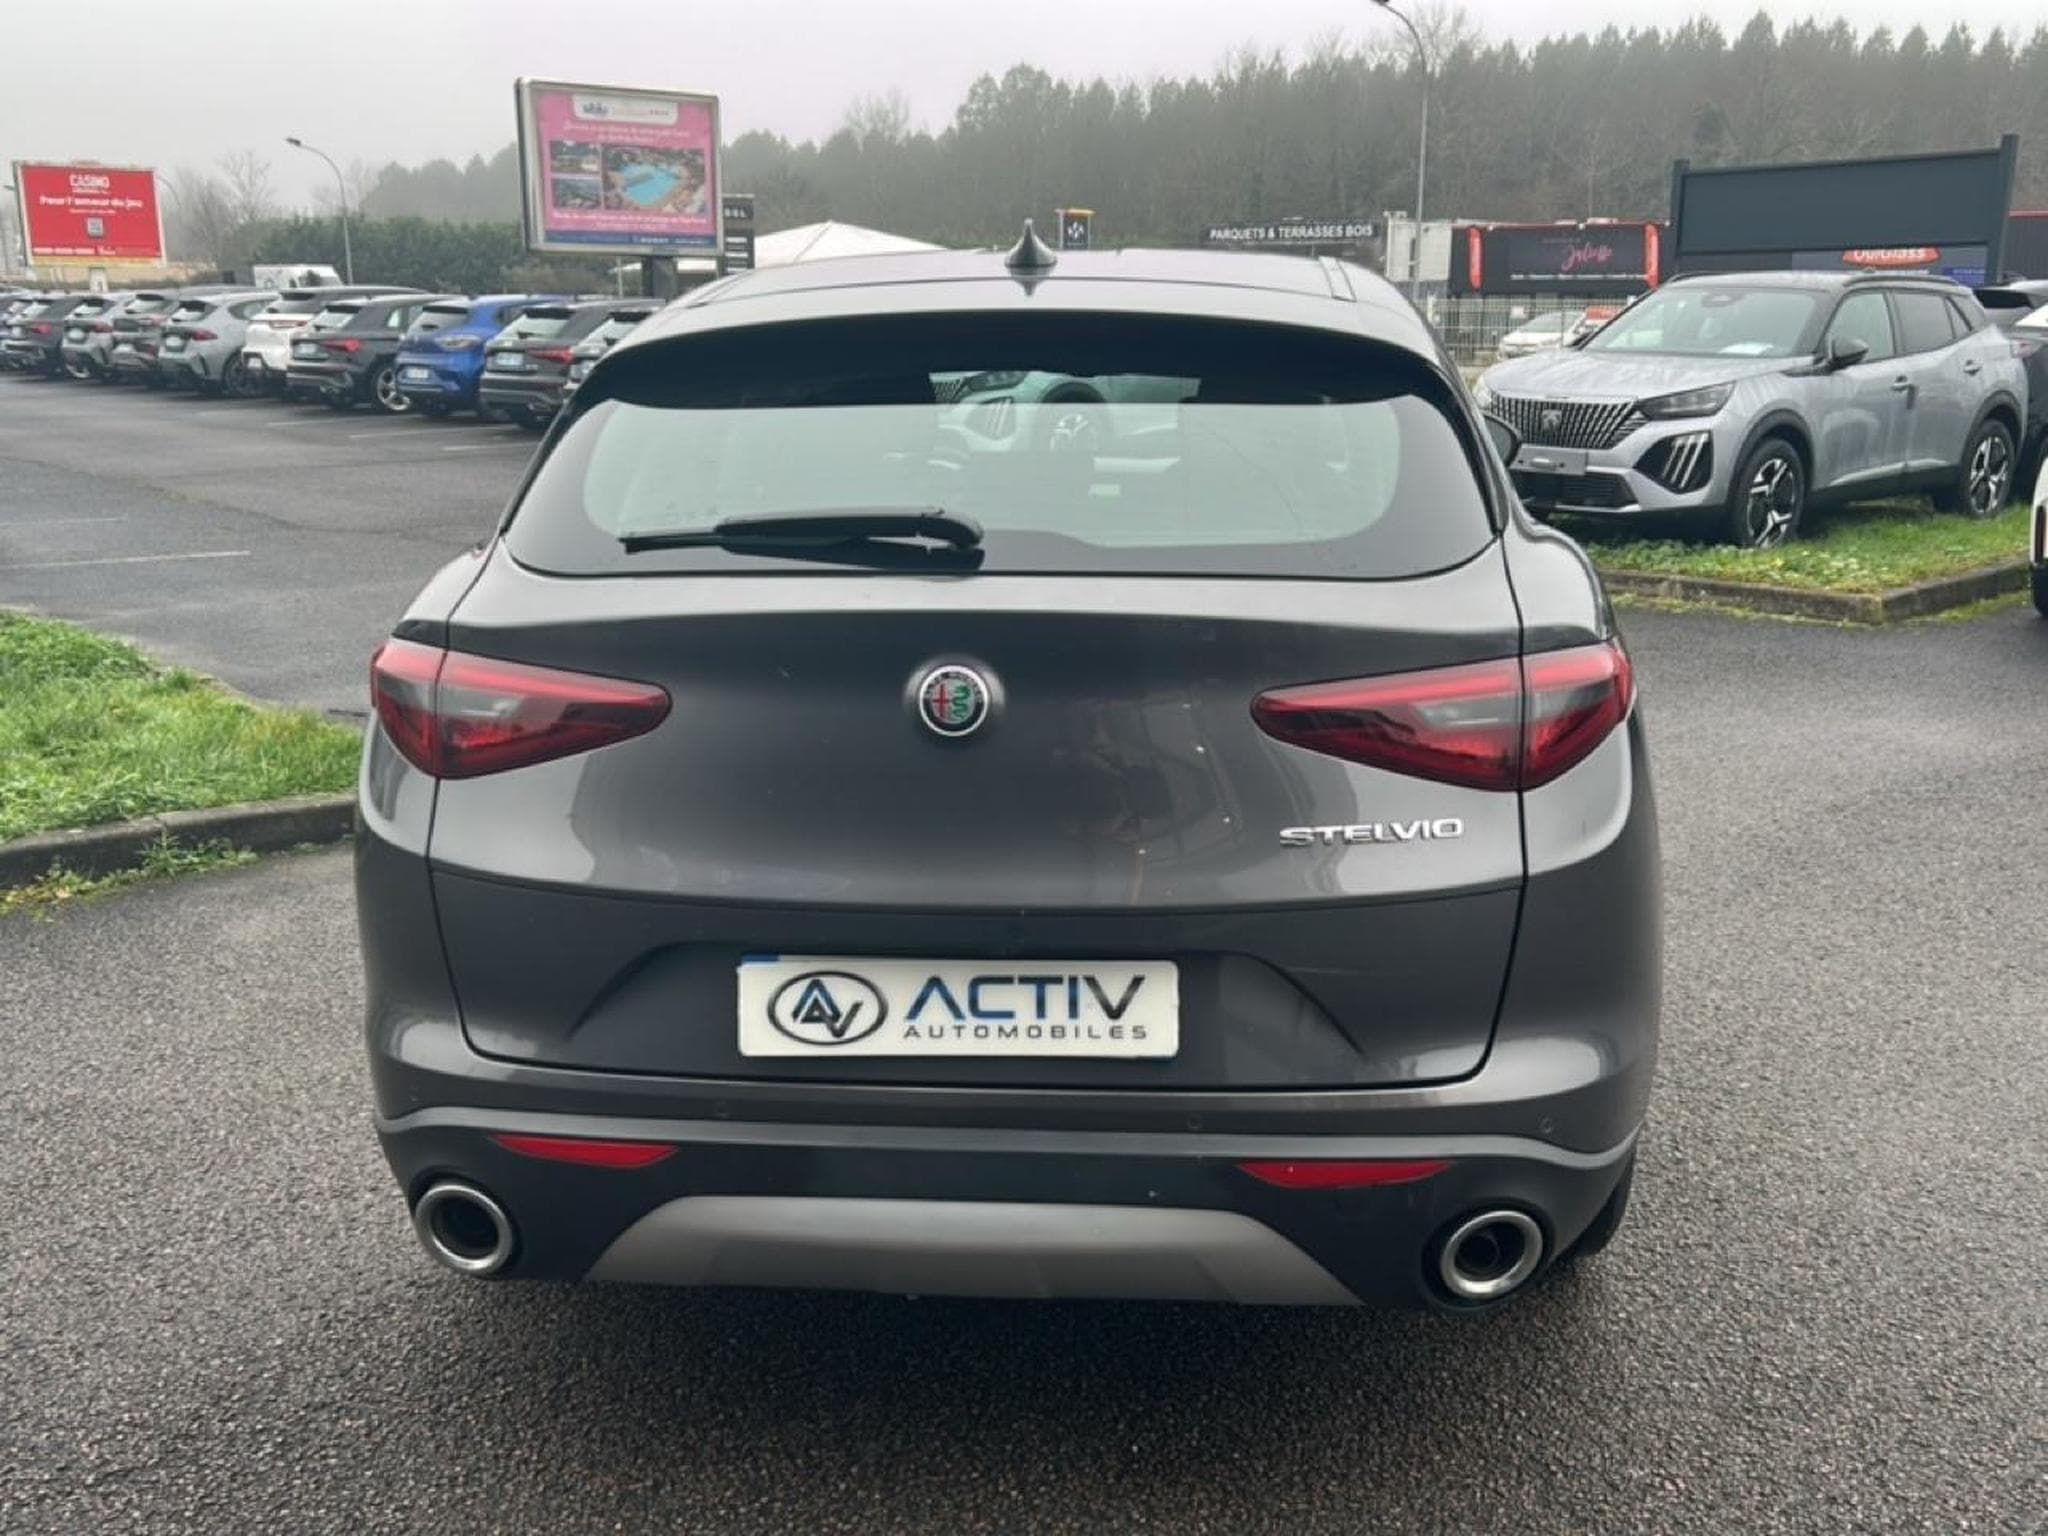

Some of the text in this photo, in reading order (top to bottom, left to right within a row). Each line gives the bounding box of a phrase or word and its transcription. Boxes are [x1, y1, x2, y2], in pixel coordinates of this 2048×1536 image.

[69, 173, 110, 188] CASINO
[1209, 225, 1373, 240] PARQUETS & TERRASSES BOIS
[1279, 817, 1465, 847] STELVIO
[905, 975, 1146, 1021] ACTIV
[902, 1024, 1148, 1040] AUTOMOBILES
